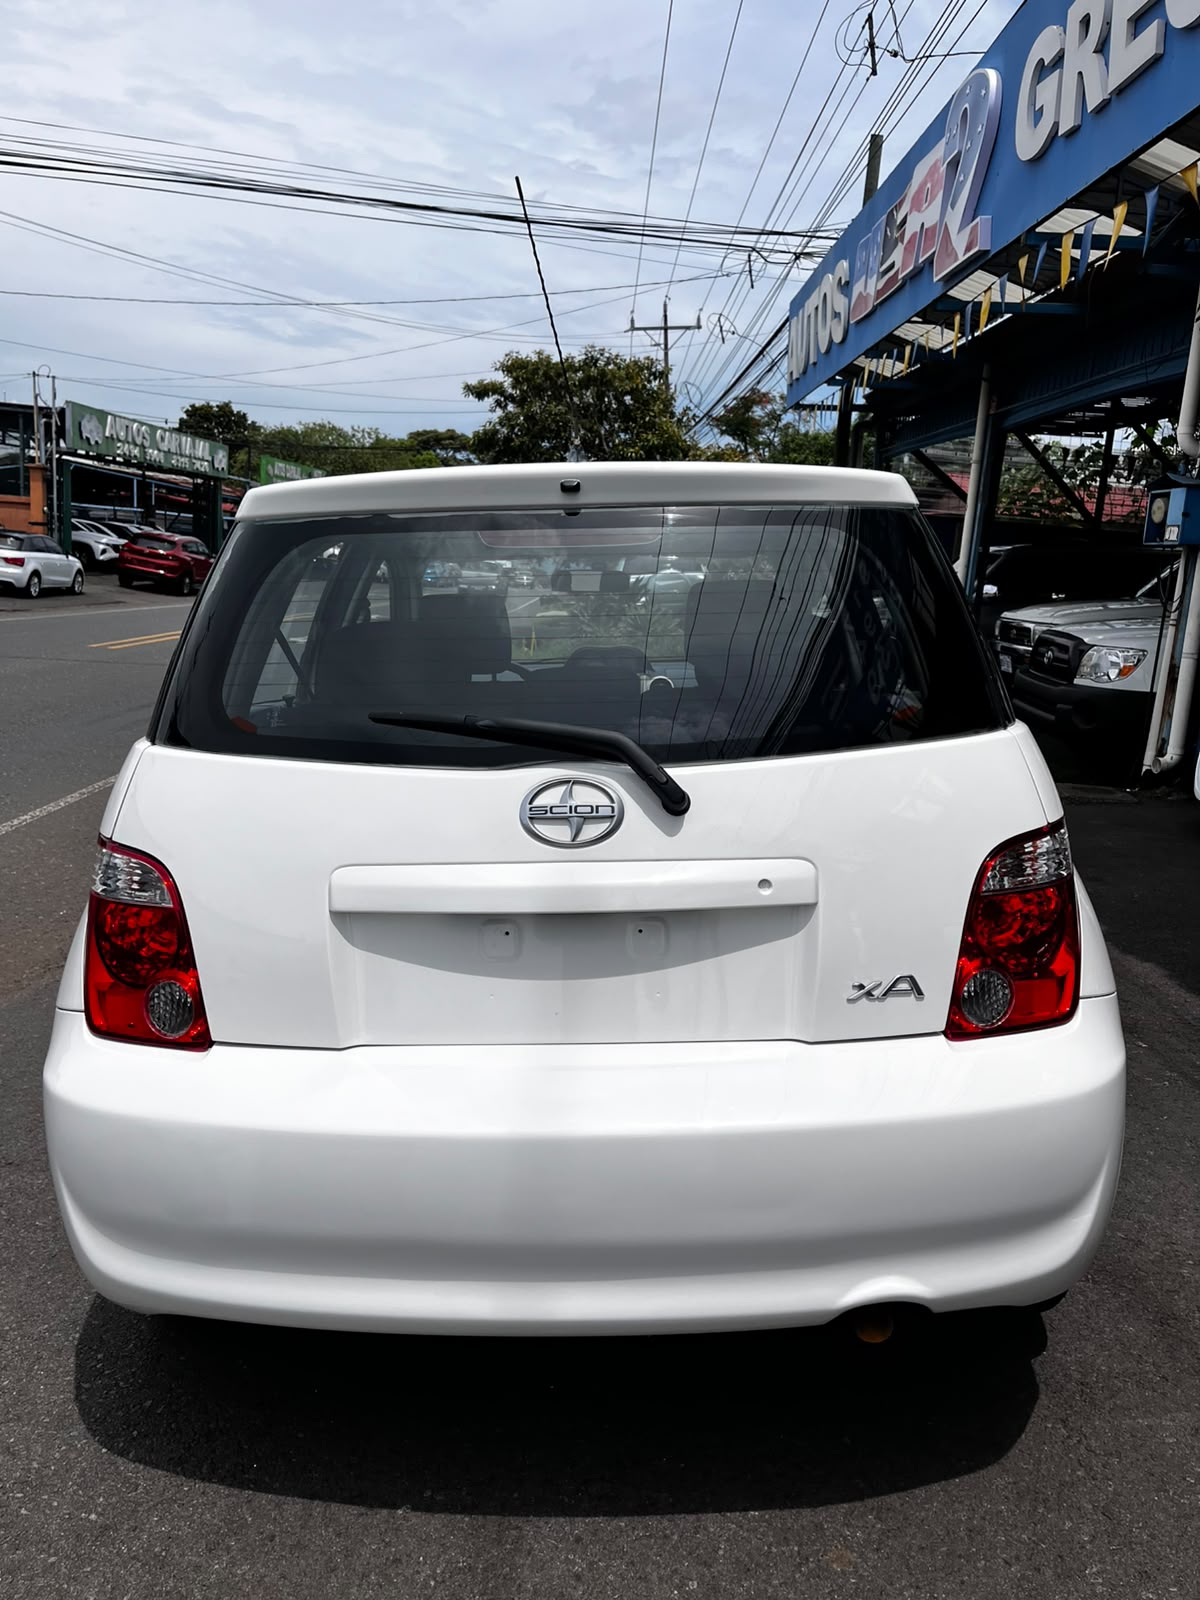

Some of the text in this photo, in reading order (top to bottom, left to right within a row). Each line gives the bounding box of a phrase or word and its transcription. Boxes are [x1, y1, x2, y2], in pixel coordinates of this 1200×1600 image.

[787, 257, 850, 386] AUTOS
[1015, 0, 1200, 161] GRE
[105, 414, 211, 461] AUTOS CARVAJAL
[528, 804, 616, 816] SCION
[846, 974, 925, 1004] xA
